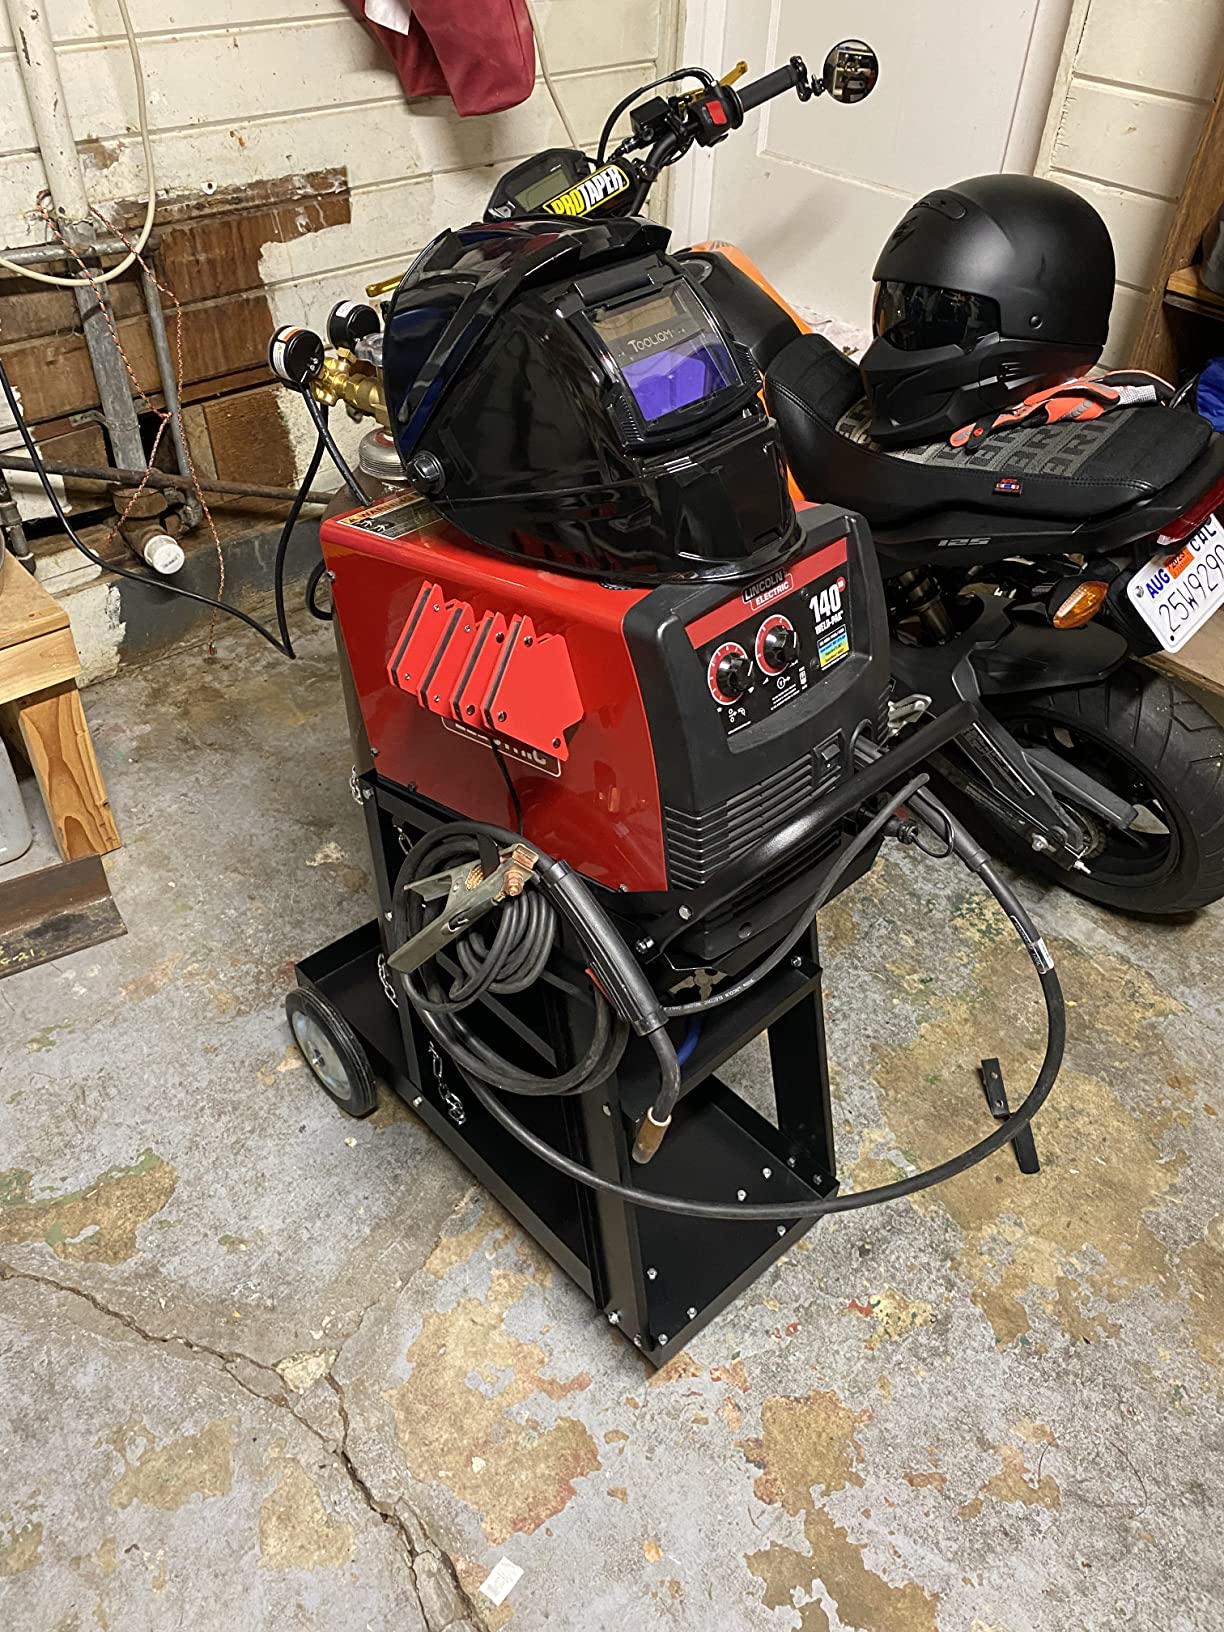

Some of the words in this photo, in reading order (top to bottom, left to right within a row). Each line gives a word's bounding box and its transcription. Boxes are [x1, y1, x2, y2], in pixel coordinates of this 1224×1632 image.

[551, 168, 624, 216] PROTAPER
[938, 537, 991, 547] 125
[743, 570, 784, 601] LINCOLN
[755, 581, 789, 606] ELECTRIC
[1145, 568, 1171, 599] AUG
[809, 583, 841, 623] 140
